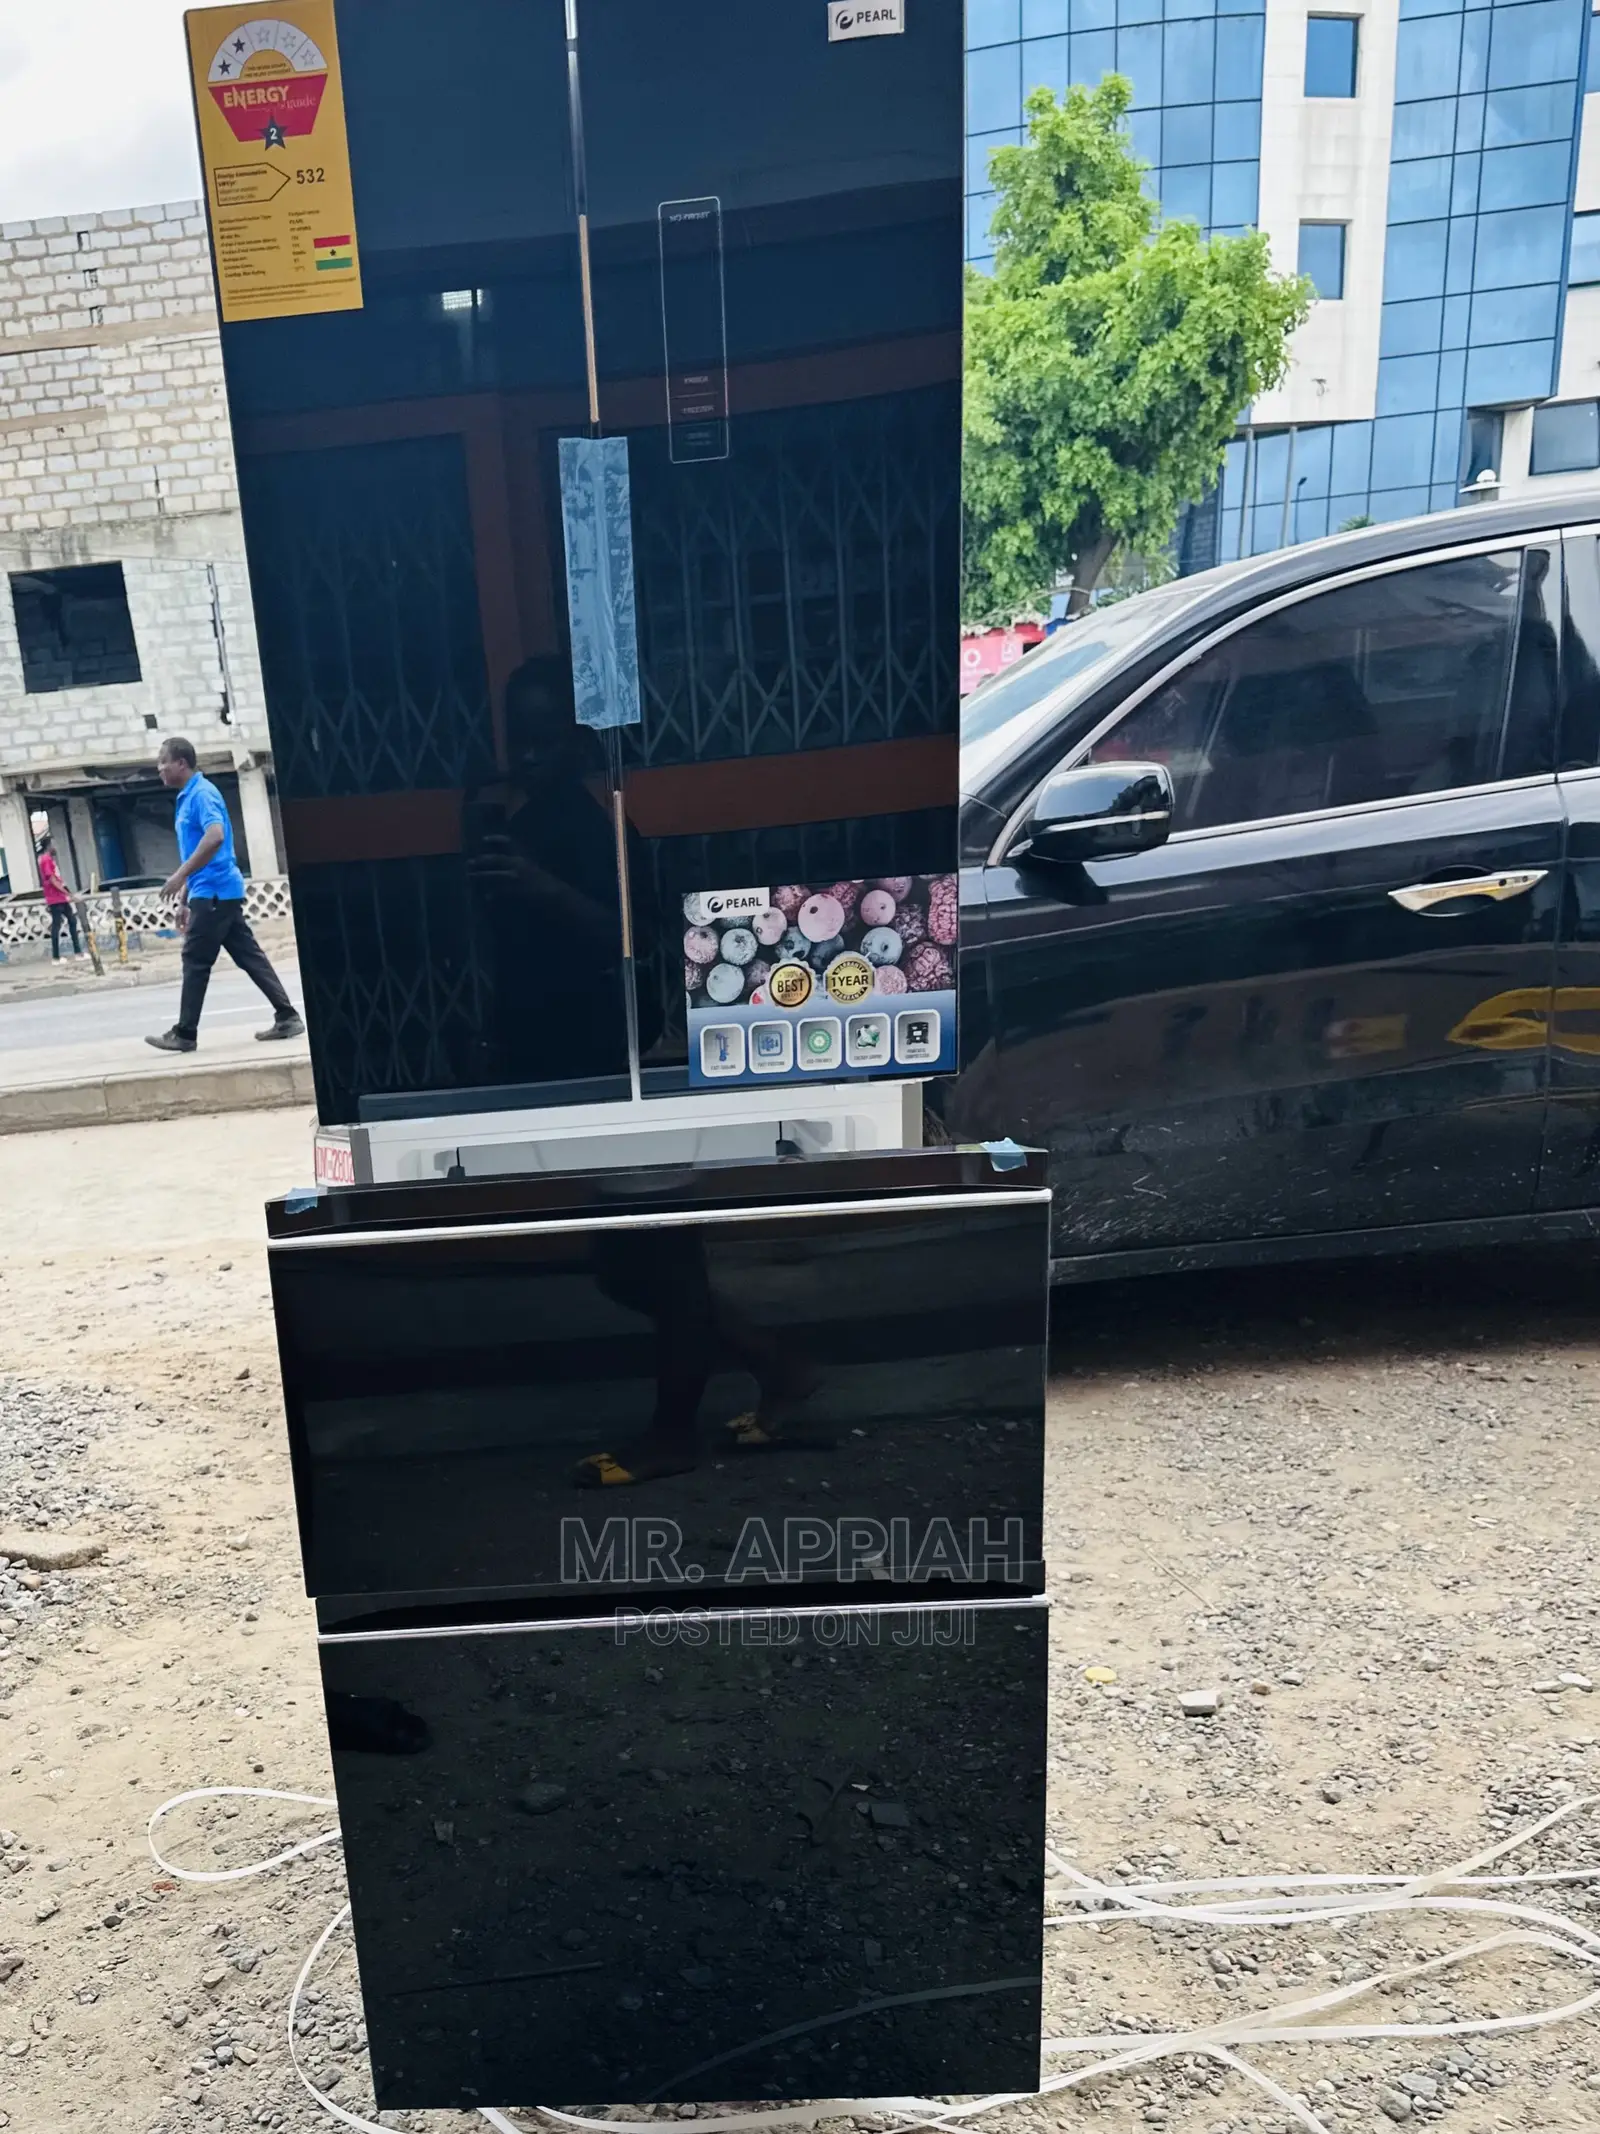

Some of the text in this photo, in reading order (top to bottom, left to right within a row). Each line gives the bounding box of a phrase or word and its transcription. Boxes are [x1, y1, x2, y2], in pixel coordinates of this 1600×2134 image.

[856, 9, 896, 23] PEARL
[223, 85, 289, 111] ENERGY
[269, 127, 278, 141] 2
[296, 167, 325, 185] 532
[726, 897, 762, 909] PEARL
[777, 979, 805, 993] BEST
[838, 975, 869, 987] YEAR
